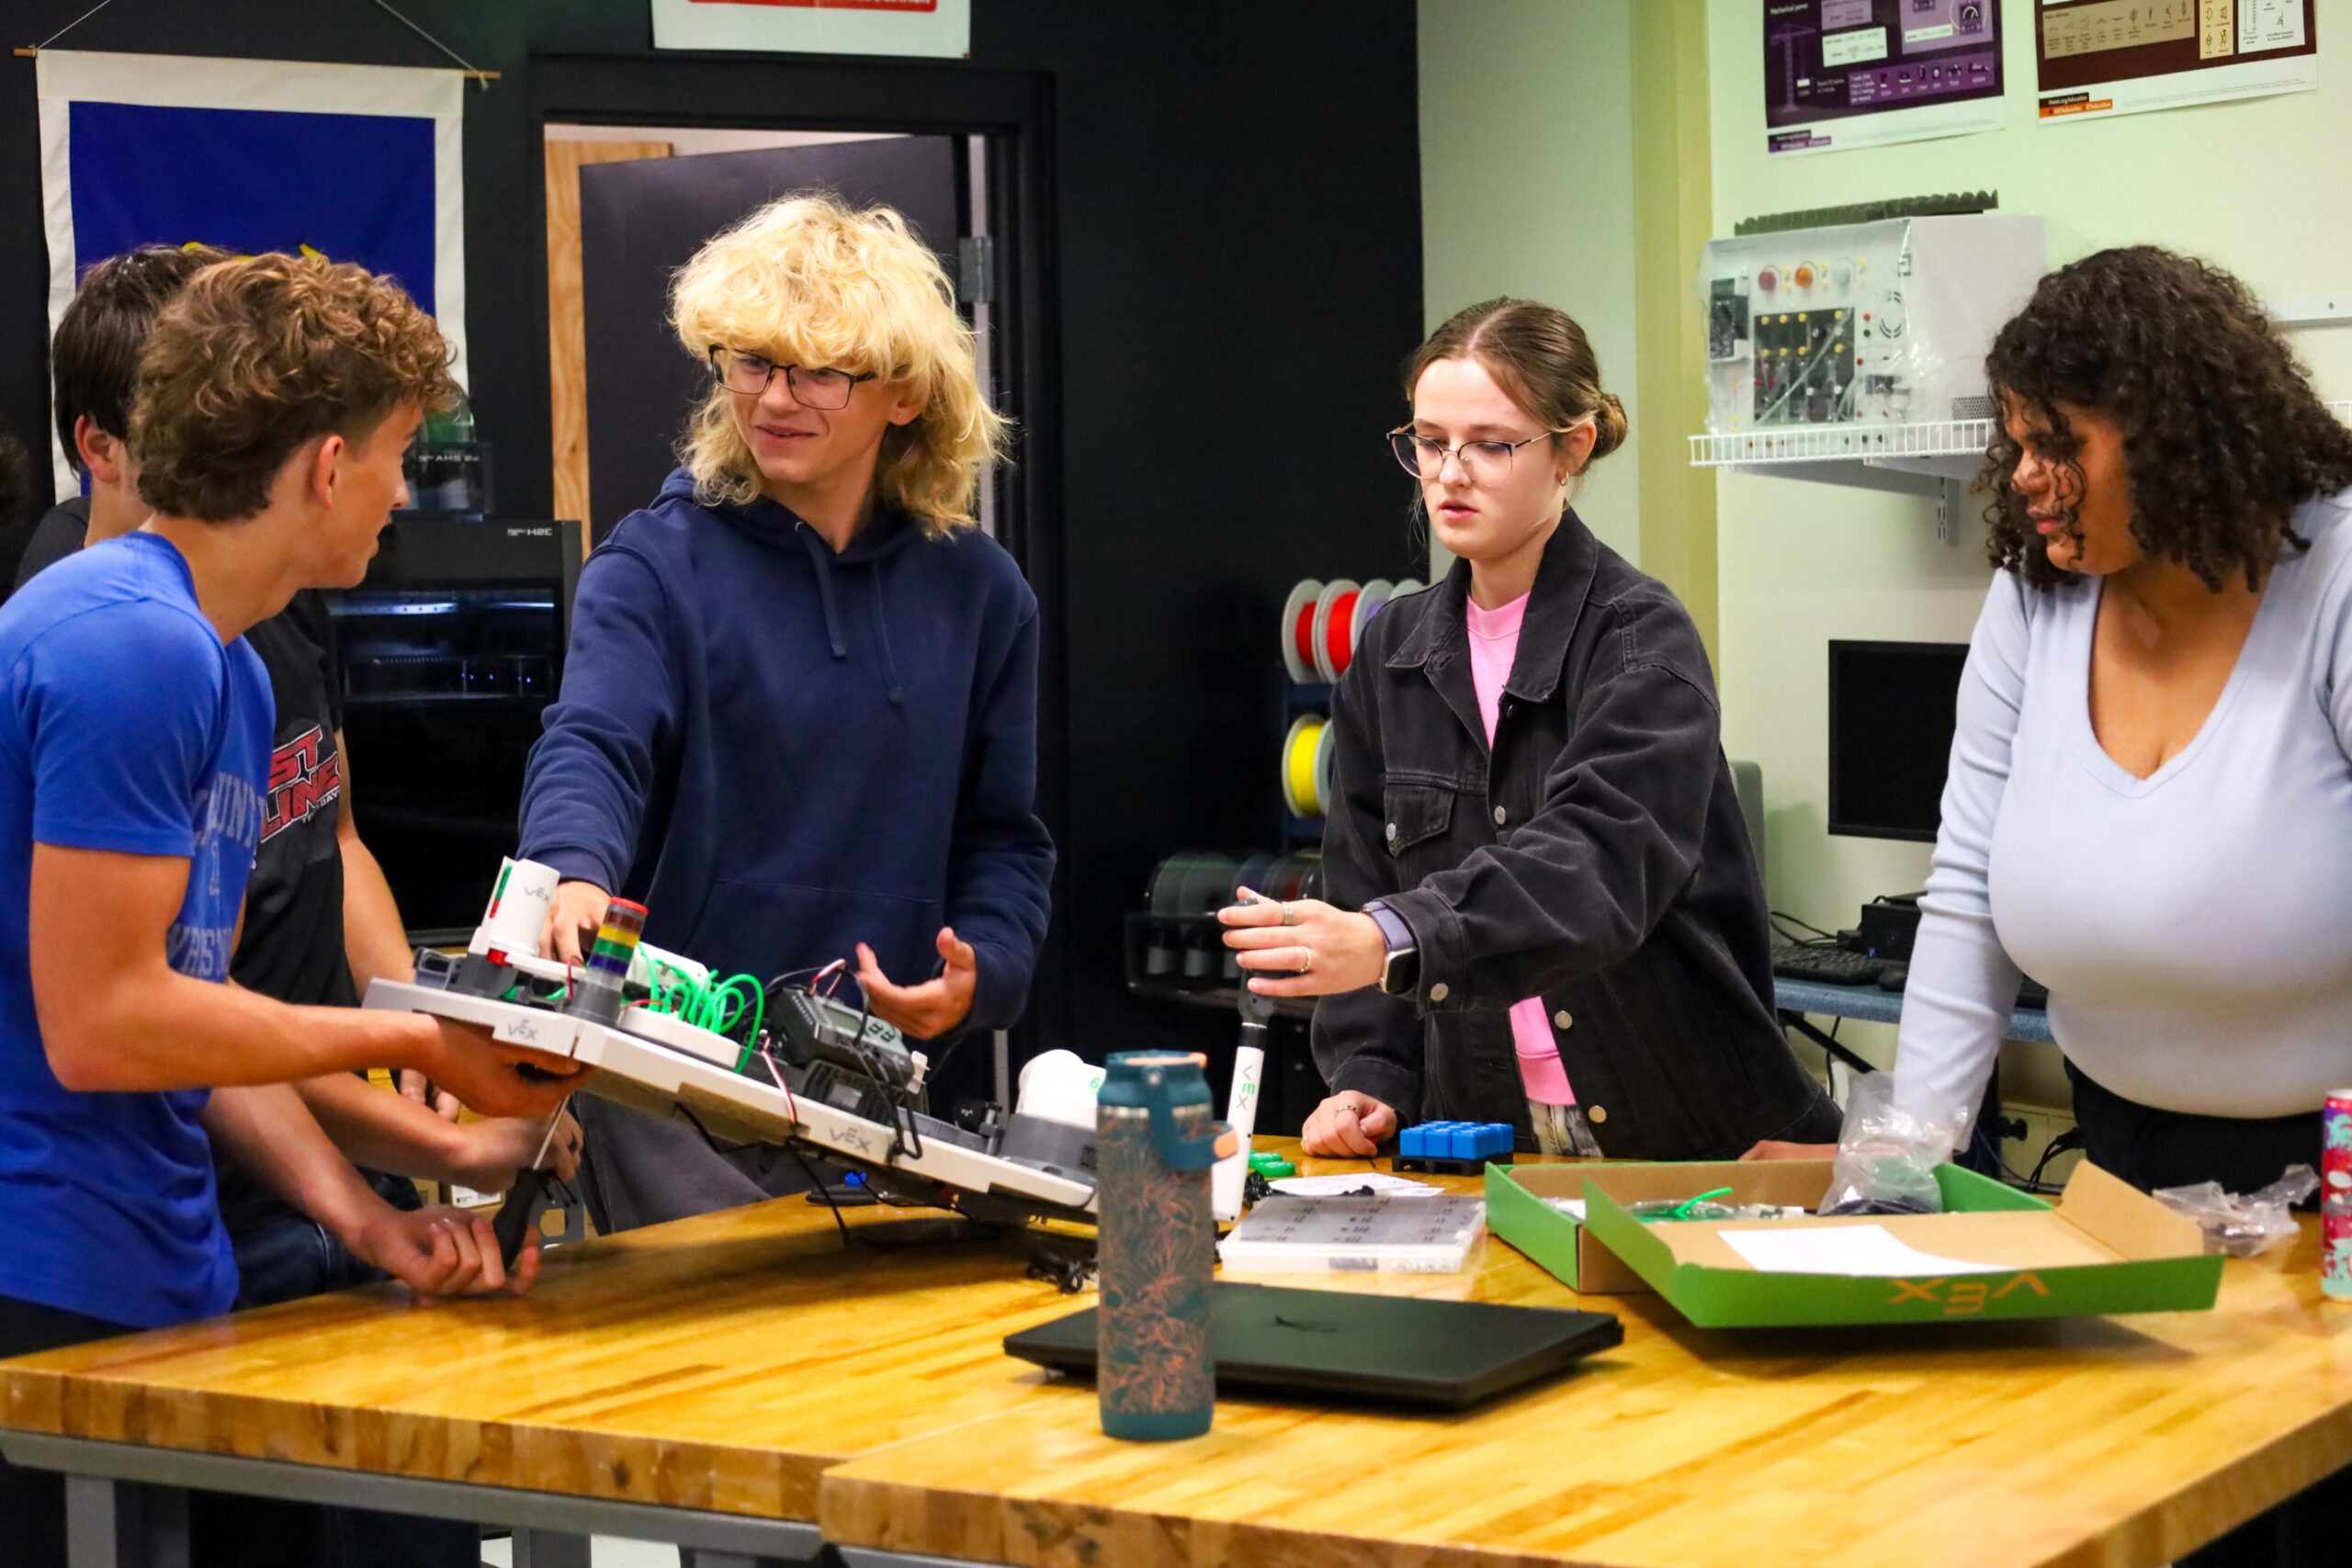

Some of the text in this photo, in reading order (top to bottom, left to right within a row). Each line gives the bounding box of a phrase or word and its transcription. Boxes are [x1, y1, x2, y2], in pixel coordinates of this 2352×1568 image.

[507, 1020, 539, 1041] VEX
[1236, 1064, 1257, 1111] VEX
[829, 1127, 872, 1153] VEX
[1887, 1272, 2049, 1316] VEX
